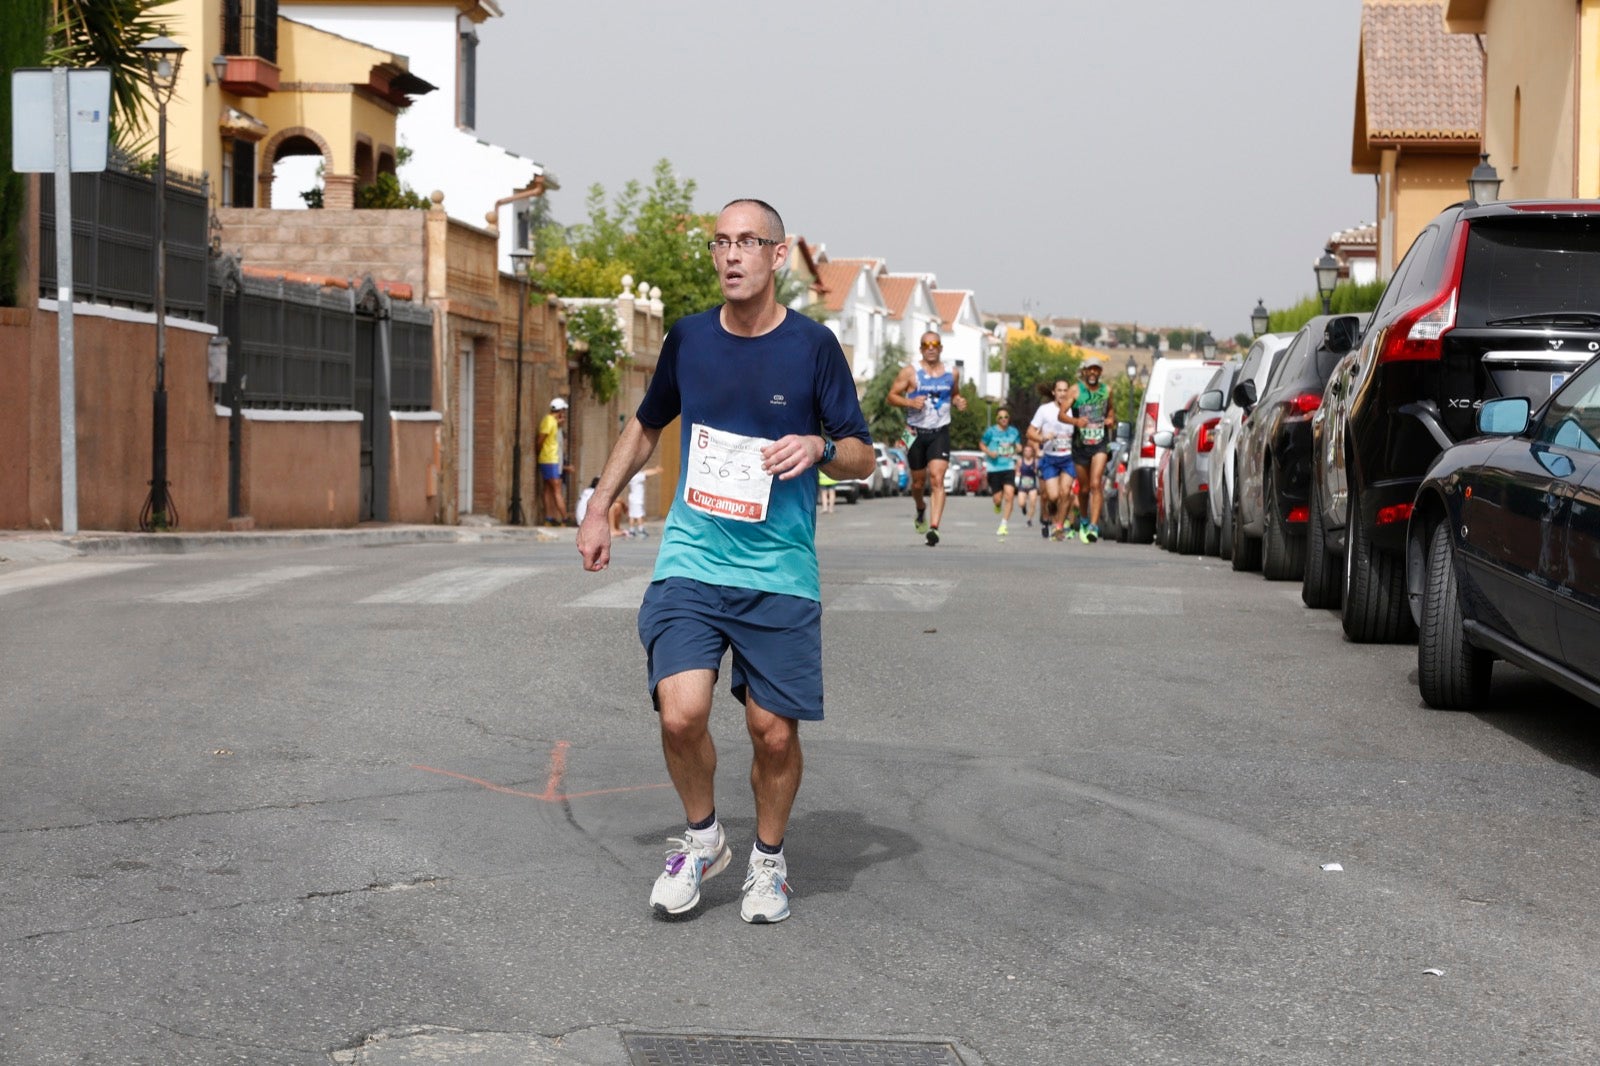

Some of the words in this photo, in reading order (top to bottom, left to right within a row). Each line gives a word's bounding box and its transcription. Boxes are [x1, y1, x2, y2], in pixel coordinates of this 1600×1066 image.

[1448, 398, 1484, 409] XC6
[699, 455, 751, 481] 563
[692, 490, 746, 515] Cruzcampo
